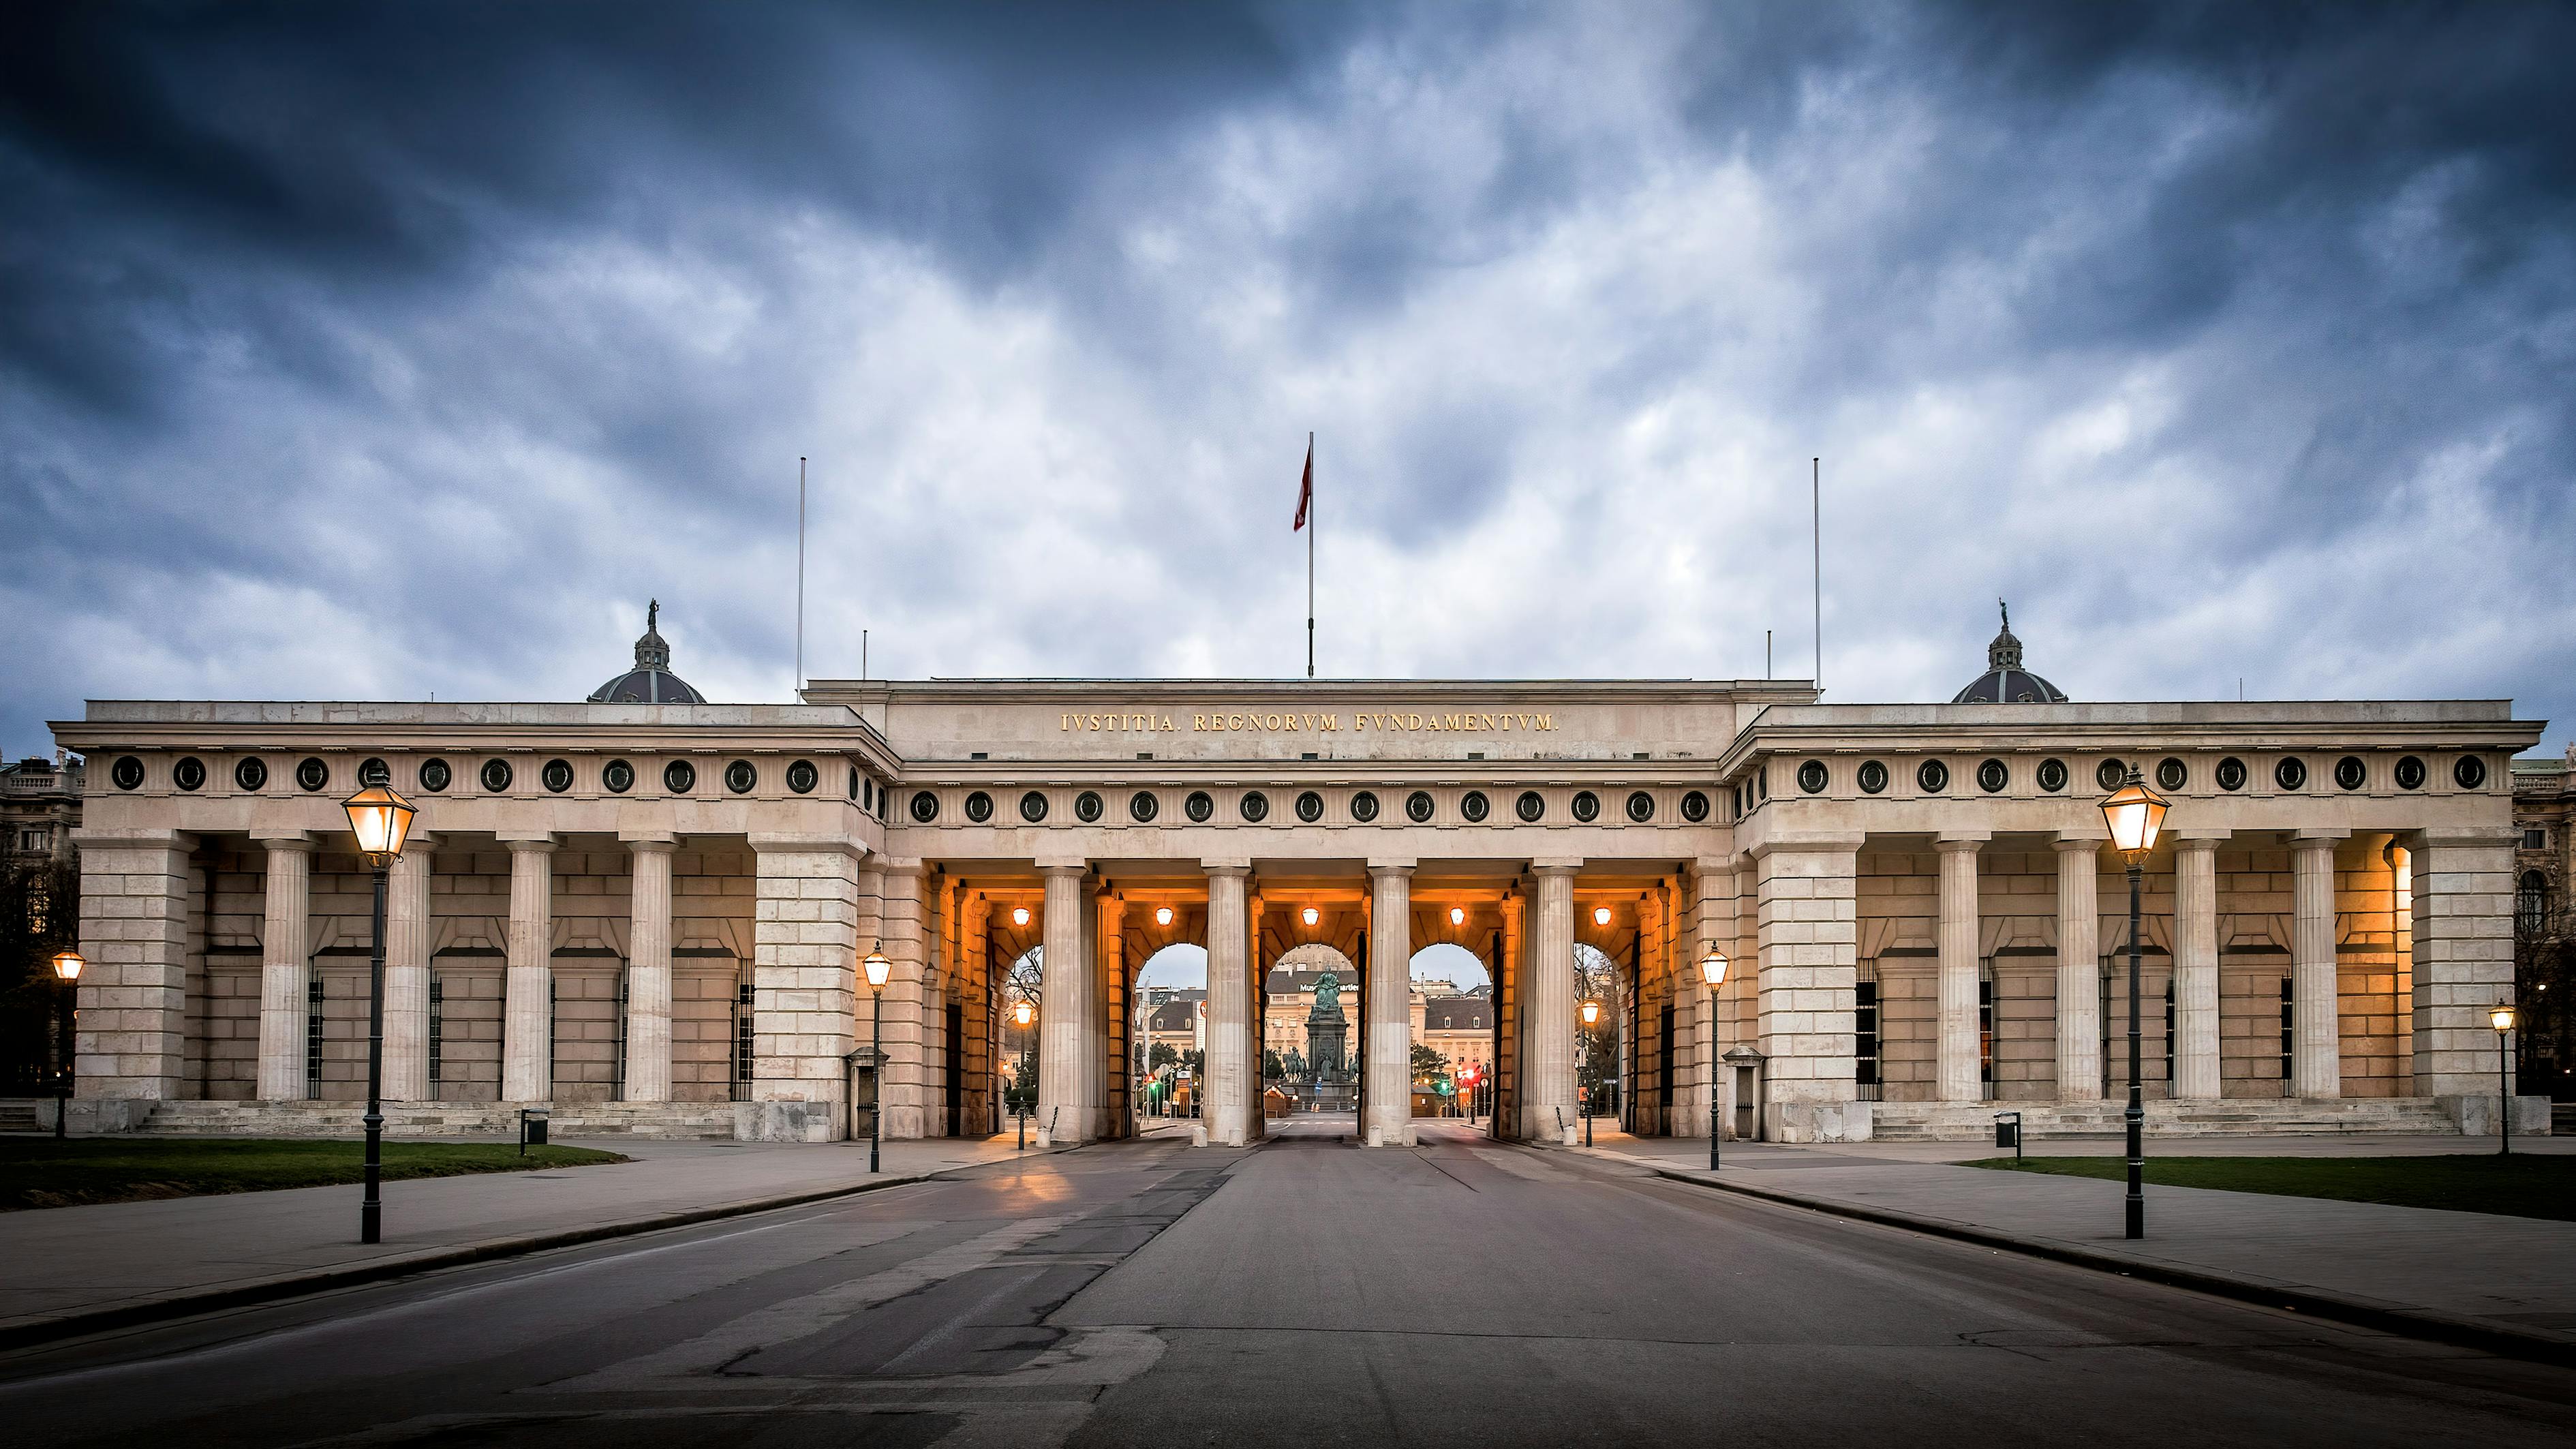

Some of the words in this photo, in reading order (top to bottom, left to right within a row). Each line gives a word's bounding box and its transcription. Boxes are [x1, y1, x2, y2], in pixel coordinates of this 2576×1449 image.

[1061, 714, 1181, 731] IVSTITIA.
[1193, 714, 1344, 731] REGNORVM.
[1355, 714, 1559, 731] FVNDAMENTVM.
